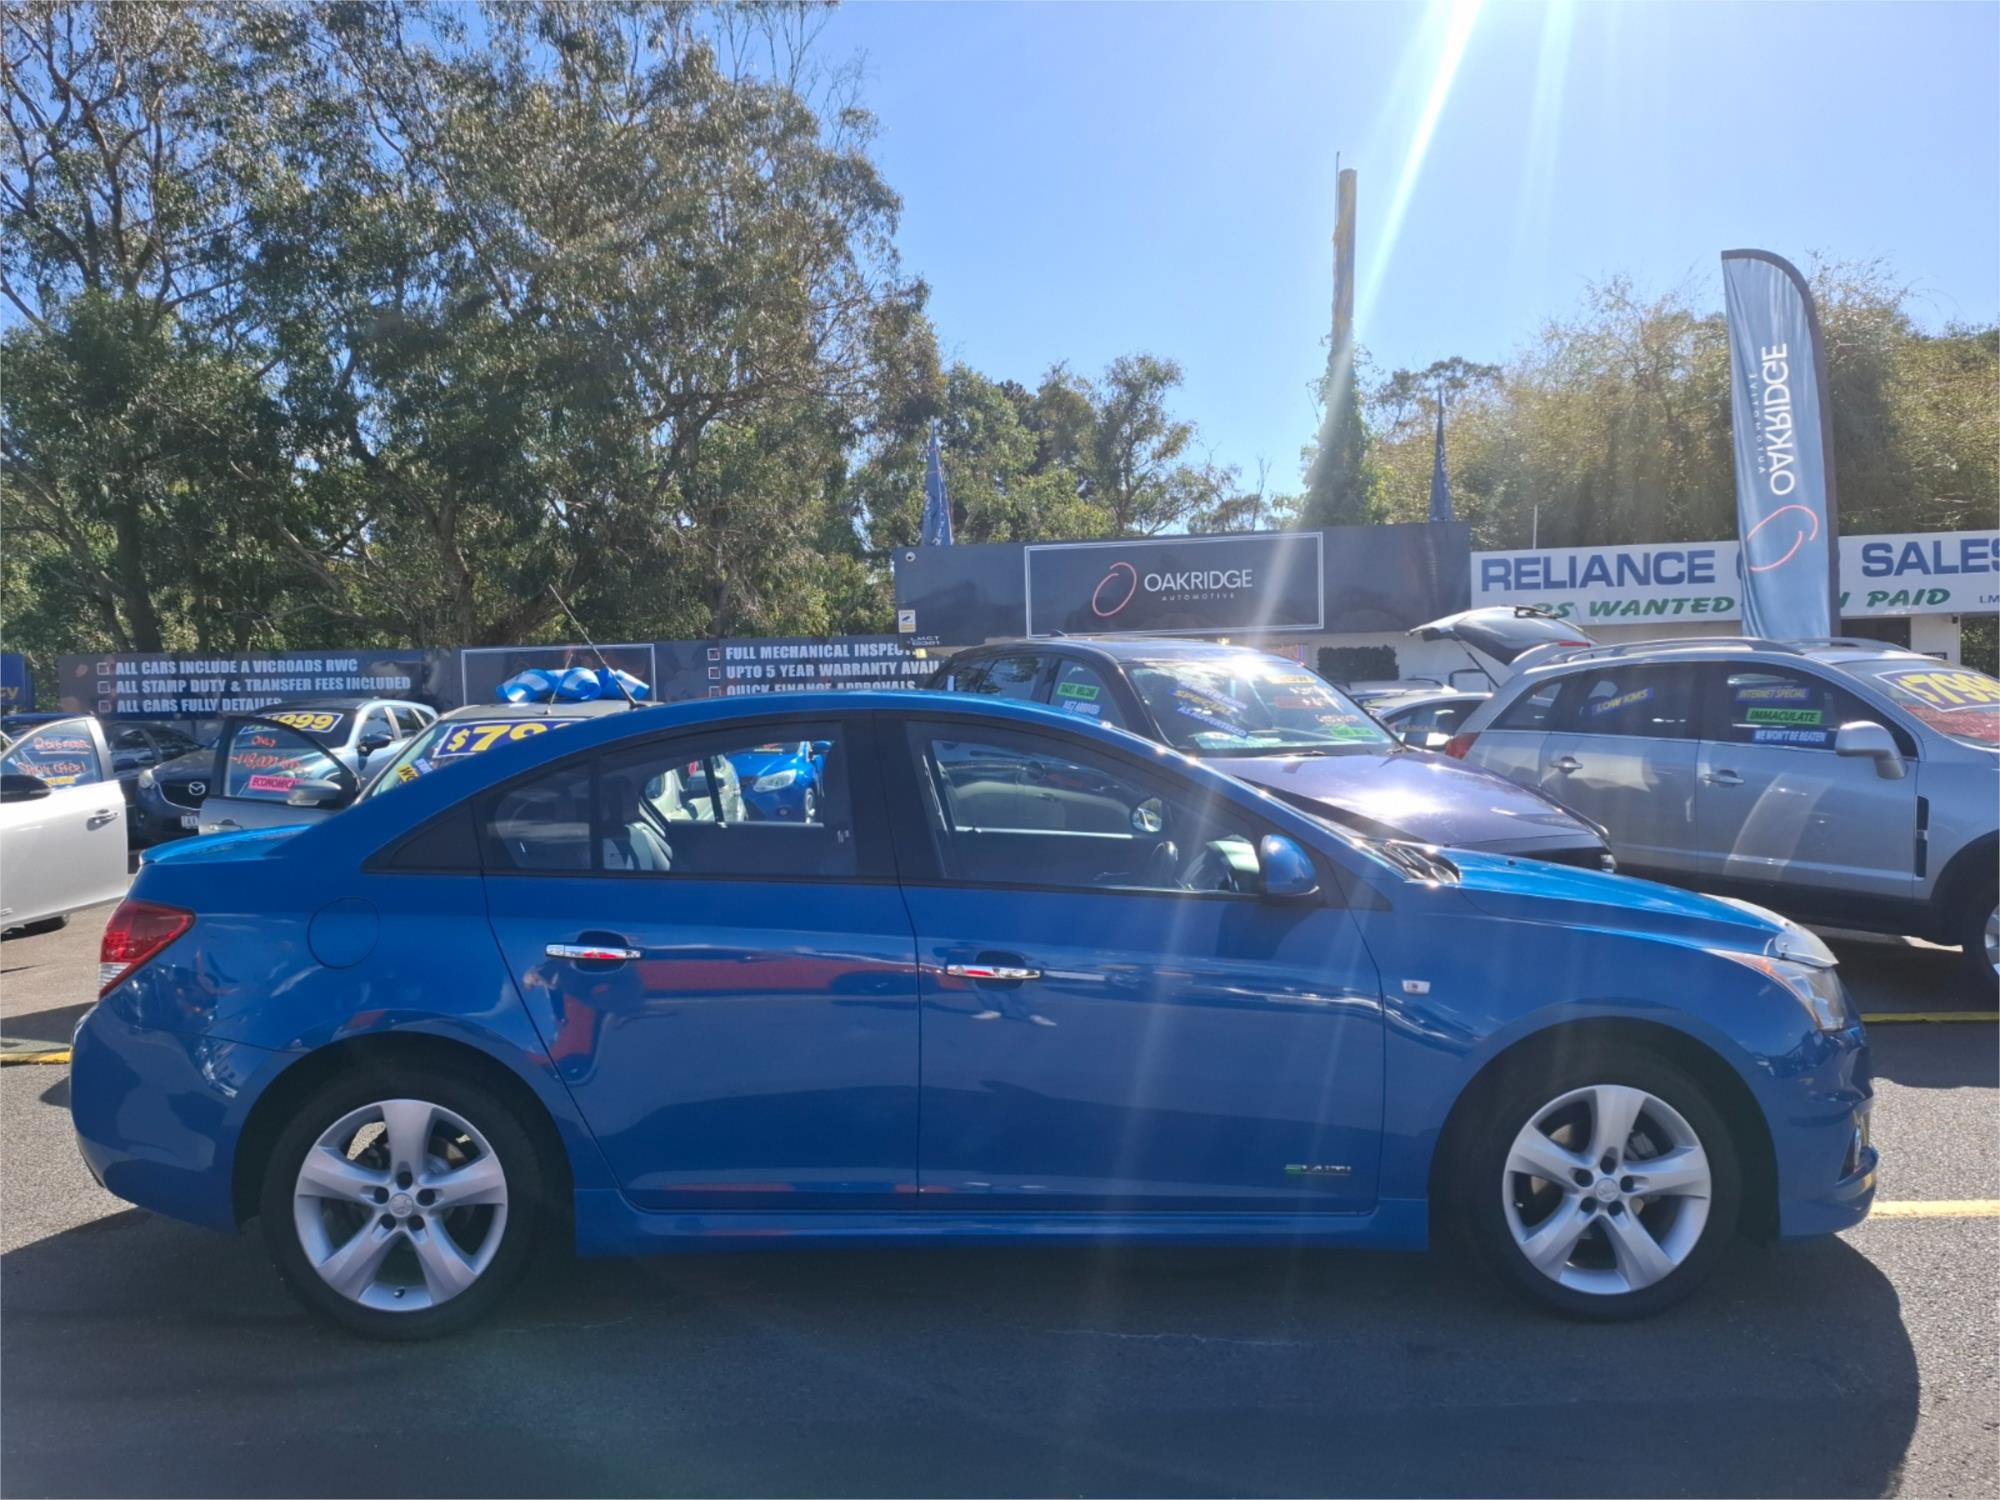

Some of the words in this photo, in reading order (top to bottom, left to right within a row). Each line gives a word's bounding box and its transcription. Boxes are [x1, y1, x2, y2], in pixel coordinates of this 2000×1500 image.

[1861, 537, 1999, 578] SALE
[1480, 549, 1716, 592] RELIANCE
[1143, 568, 1253, 592] OAKRIDGE
[1161, 592, 1235, 601] AUTOMOTIVE
[1866, 587, 1951, 608] PAID
[1589, 595, 1735, 617] WANTED
[725, 646, 756, 660] FULL
[760, 644, 850, 659] MECHANICAL
[115, 661, 138, 675] ALL
[141, 661, 177, 675] CARS
[179, 660, 237, 674] INCLUDE
[240, 660, 250, 673] A
[252, 659, 322, 674] VICROADS
[325, 658, 358, 672] RWC
[726, 664, 762, 679] UPTO
[766, 664, 776, 678] 5
[779, 663, 815, 678] YEAR
[818, 661, 897, 677] WARRANTY
[115, 680, 138, 694] ALL
[141, 680, 187, 693] STAMP
[190, 679, 226, 693] DUTY
[230, 680, 241, 693] &
[244, 678, 312, 692] TRANSFER
[315, 677, 344, 691] FEES
[346, 676, 411, 690] INCLUDED
[117, 700, 138, 713] ALL
[142, 699, 176, 713] CARS
[181, 699, 219, 712] FULLY
[1750, 709, 1818, 722] IMMACULATE
